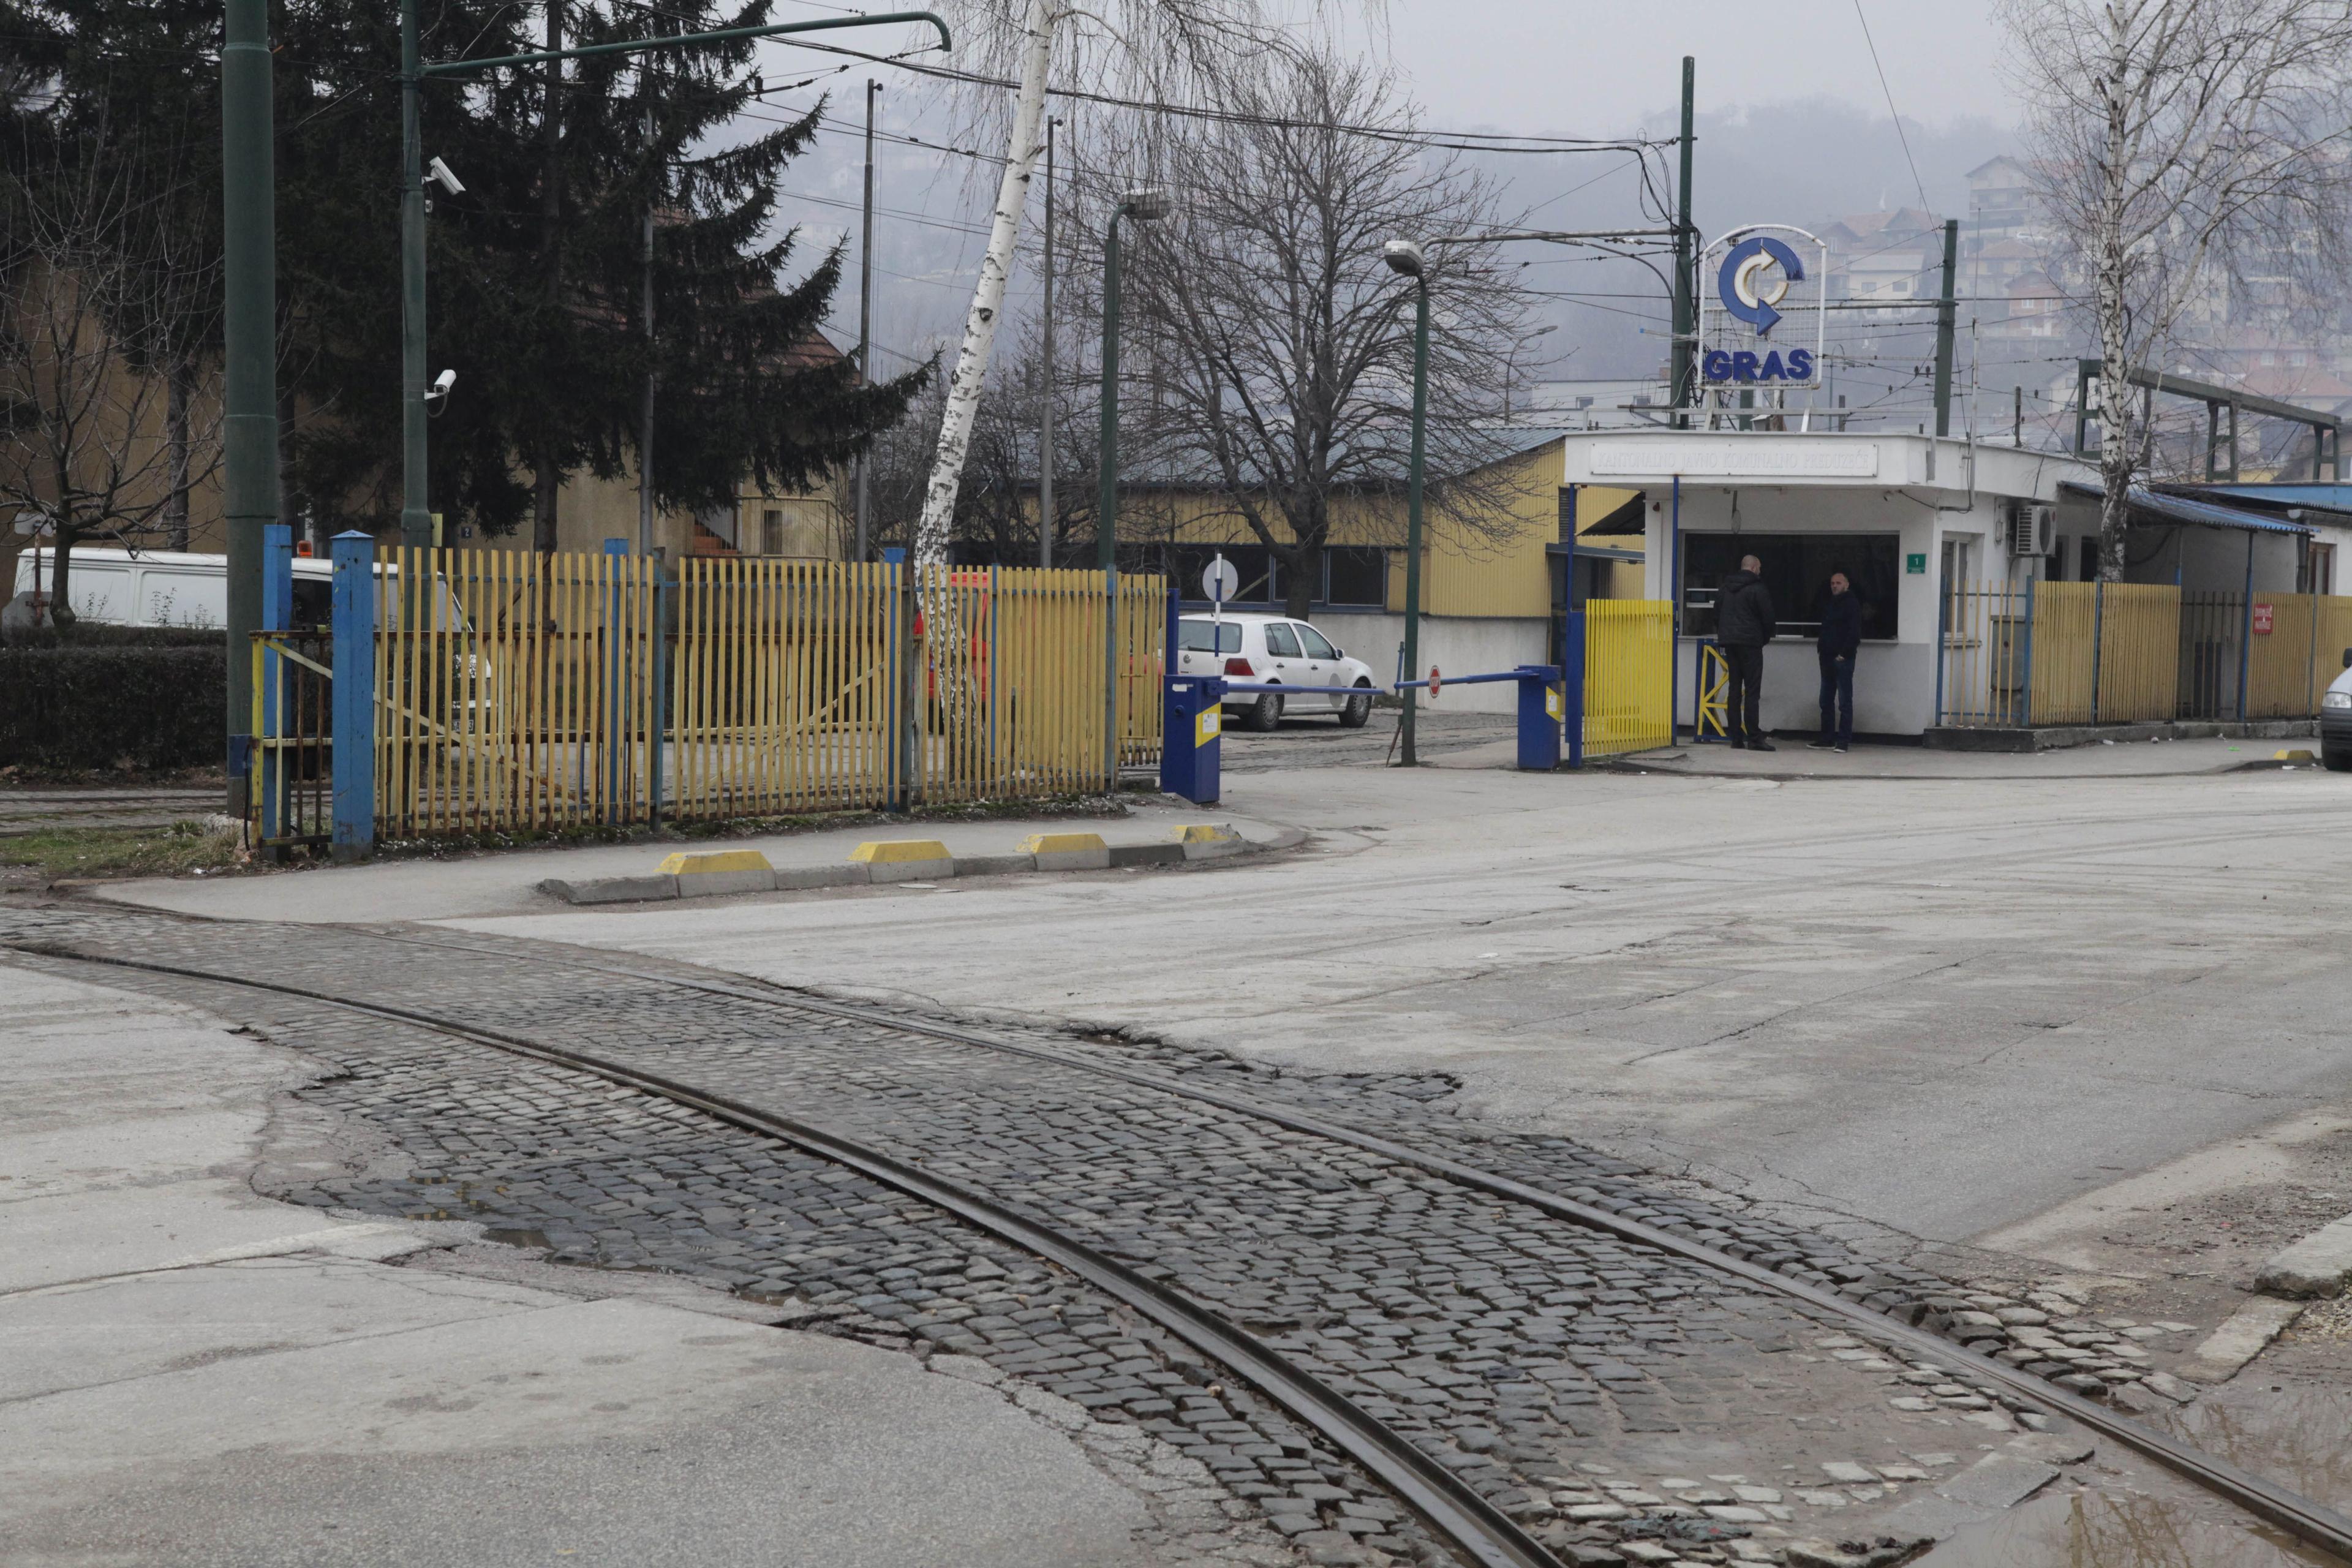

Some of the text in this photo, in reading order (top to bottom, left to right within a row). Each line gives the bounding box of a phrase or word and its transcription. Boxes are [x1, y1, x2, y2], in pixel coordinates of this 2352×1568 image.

[1705, 349, 1813, 380] GRAS
[1597, 452, 1676, 468] KANTONALNO
[1680, 452, 1718, 471] JAVNO
[1722, 452, 1798, 469] KOMUNALNO
[465, 527, 470, 537] 2
[1431, 676, 1439, 687] STOP
